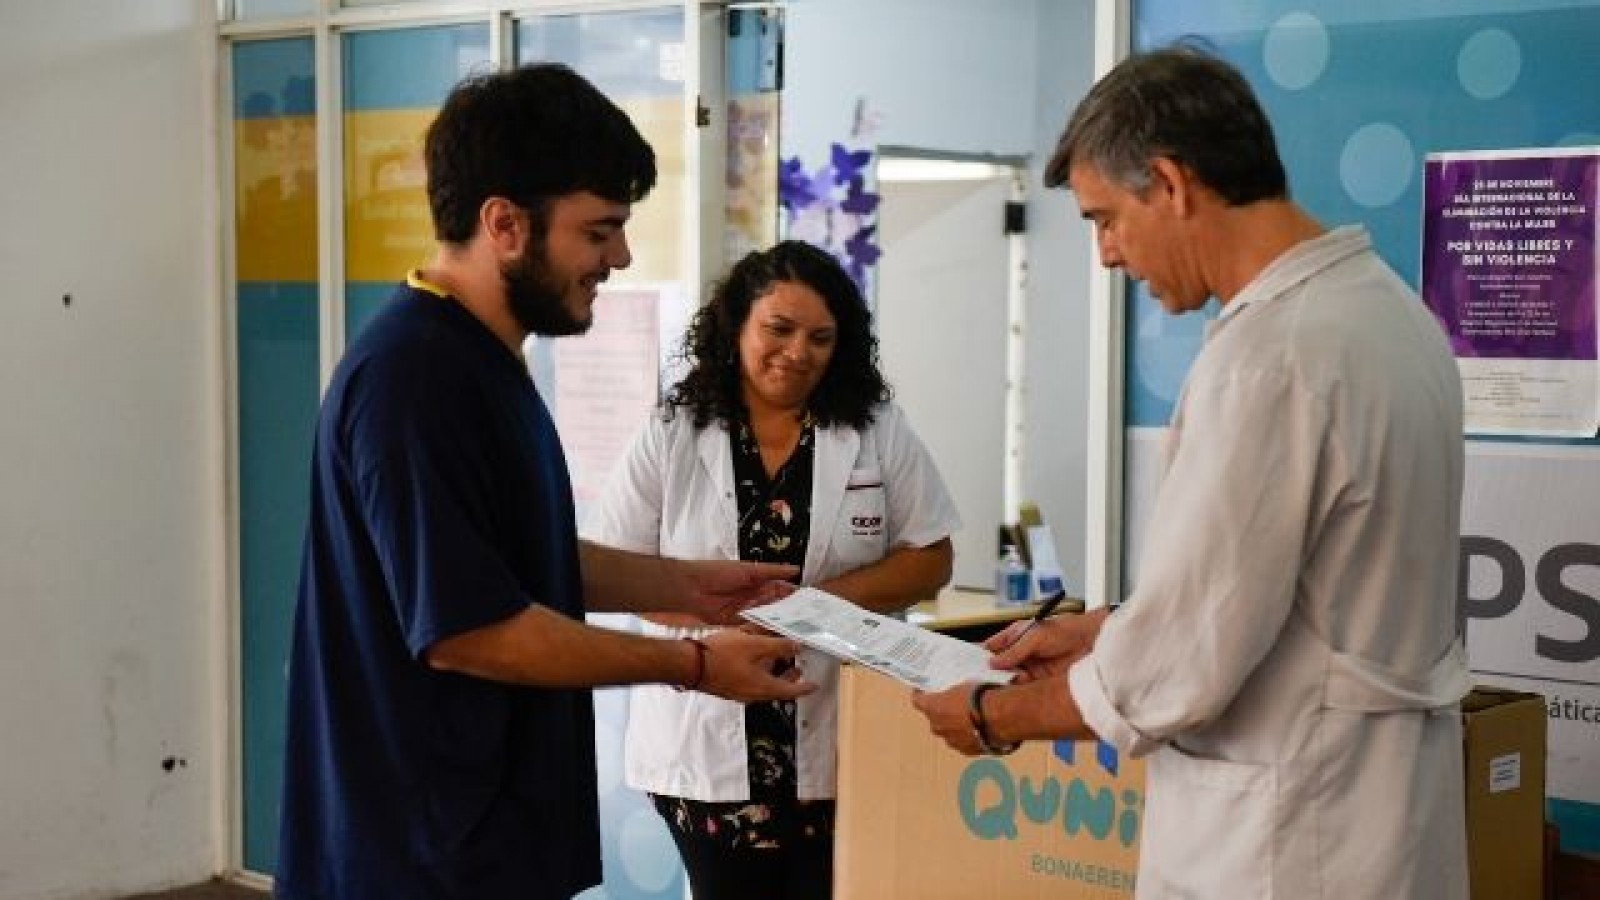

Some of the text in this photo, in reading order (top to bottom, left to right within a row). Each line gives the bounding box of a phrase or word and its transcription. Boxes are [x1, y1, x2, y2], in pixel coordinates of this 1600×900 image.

[1562, 192, 1576, 201] LA
[1447, 239, 1574, 251] POR VIDAS LIBRES Y
[1462, 254, 1556, 266] SIN VIOLENCIA
